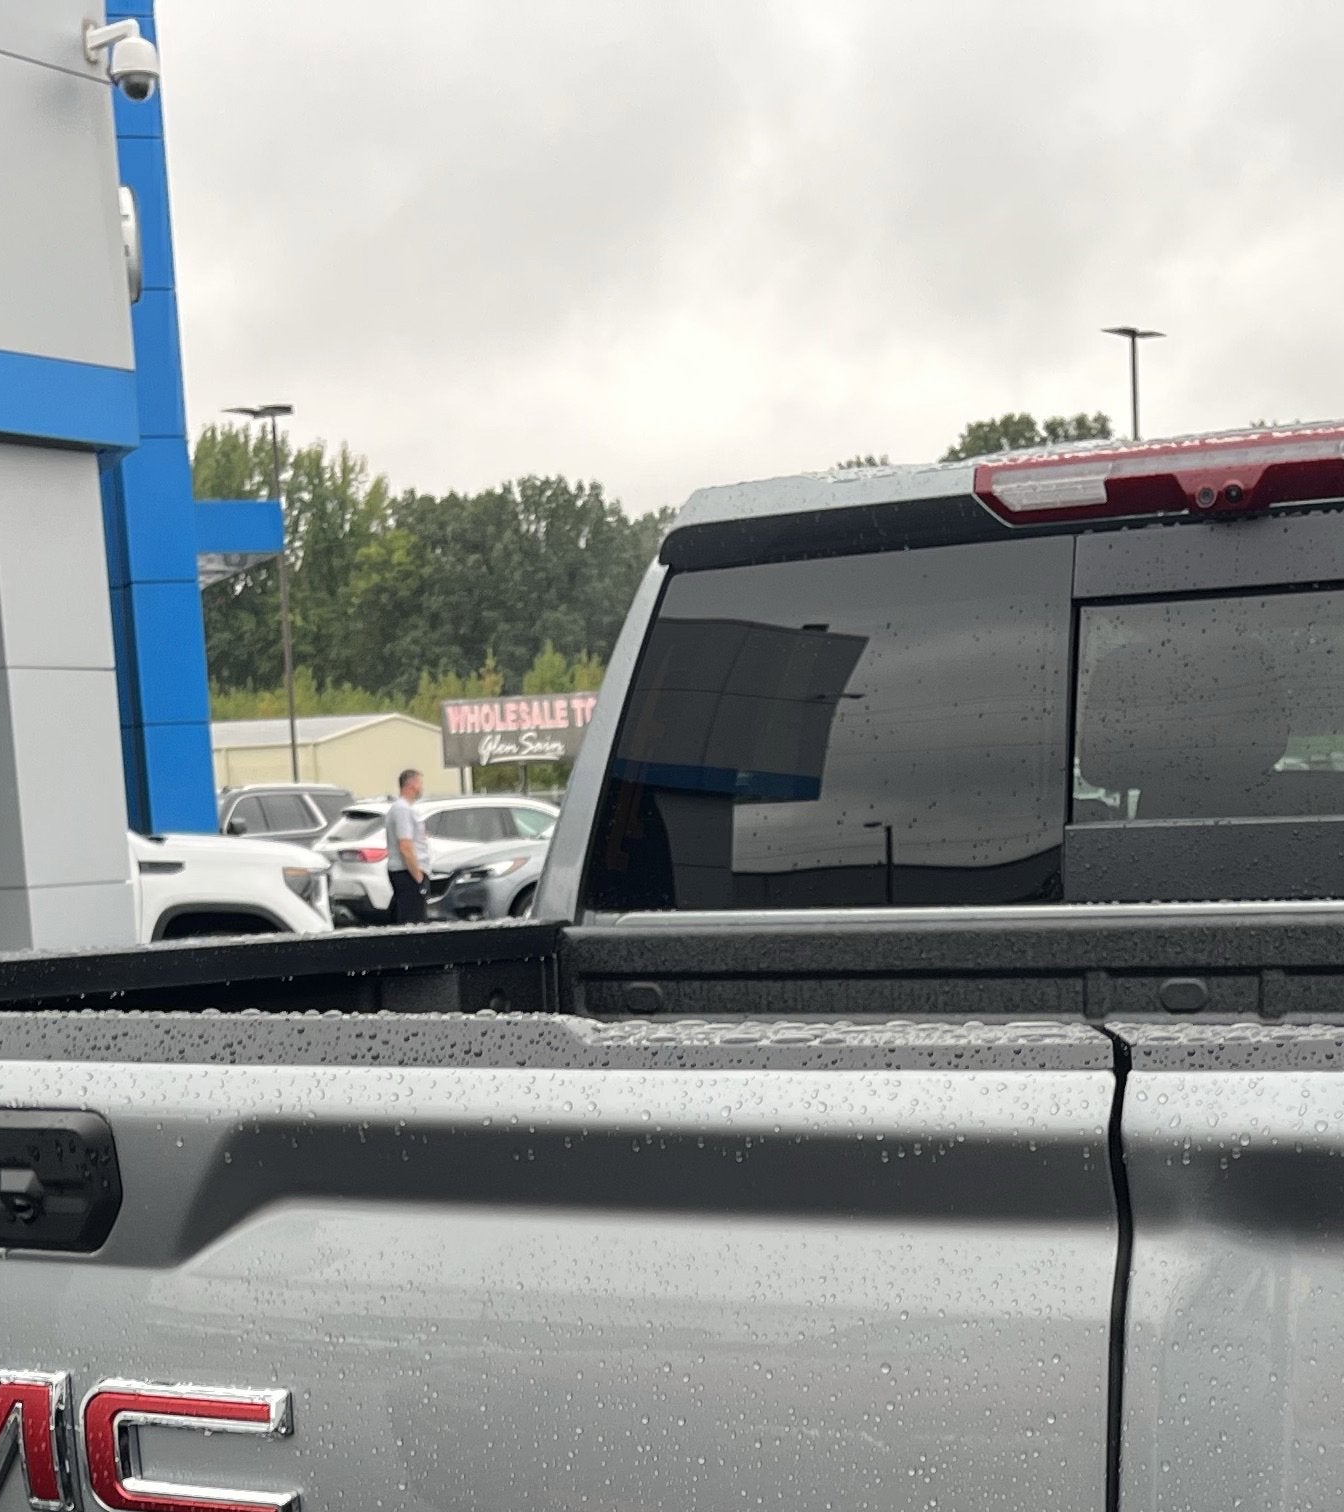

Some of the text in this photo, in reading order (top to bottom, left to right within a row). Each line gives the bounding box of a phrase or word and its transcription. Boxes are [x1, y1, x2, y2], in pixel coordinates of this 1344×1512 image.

[446, 700, 568, 733] WHOLESALE
[478, 732, 565, 766] Glen Sain
